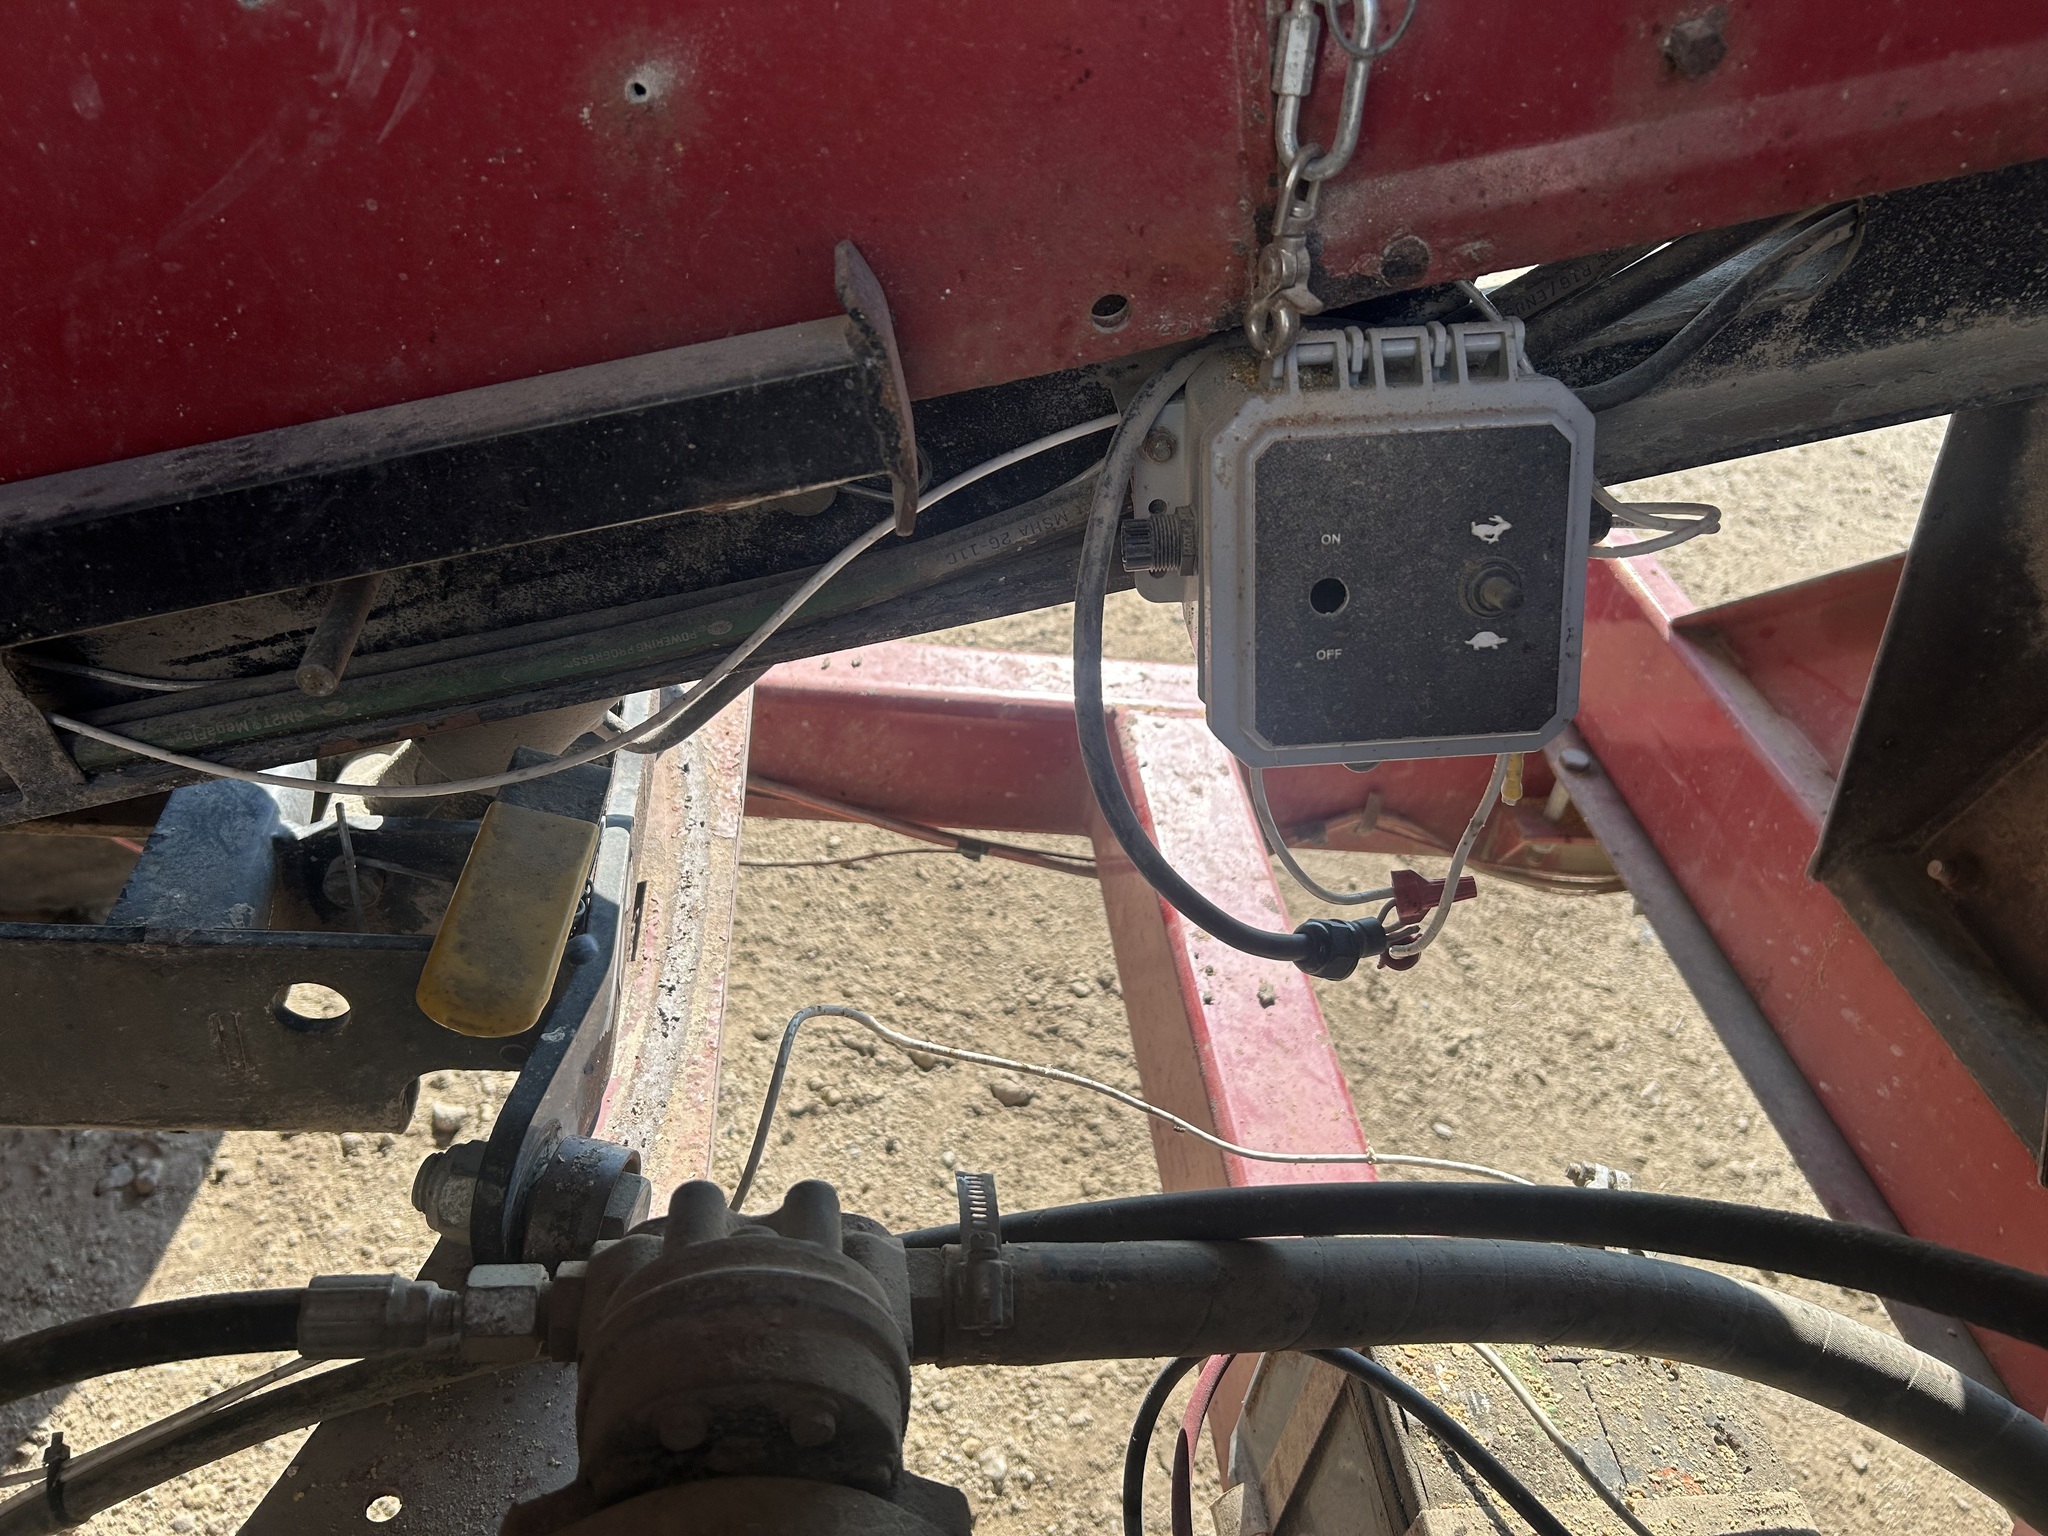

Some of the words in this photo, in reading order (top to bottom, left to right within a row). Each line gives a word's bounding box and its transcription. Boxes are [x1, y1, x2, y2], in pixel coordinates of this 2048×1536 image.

[1504, 263, 1592, 317] R16/EN85
[1018, 510, 1069, 537] MSHA
[1321, 533, 1341, 545] ON
[635, 632, 698, 650] POWERING
[1316, 649, 1342, 661] OFF
